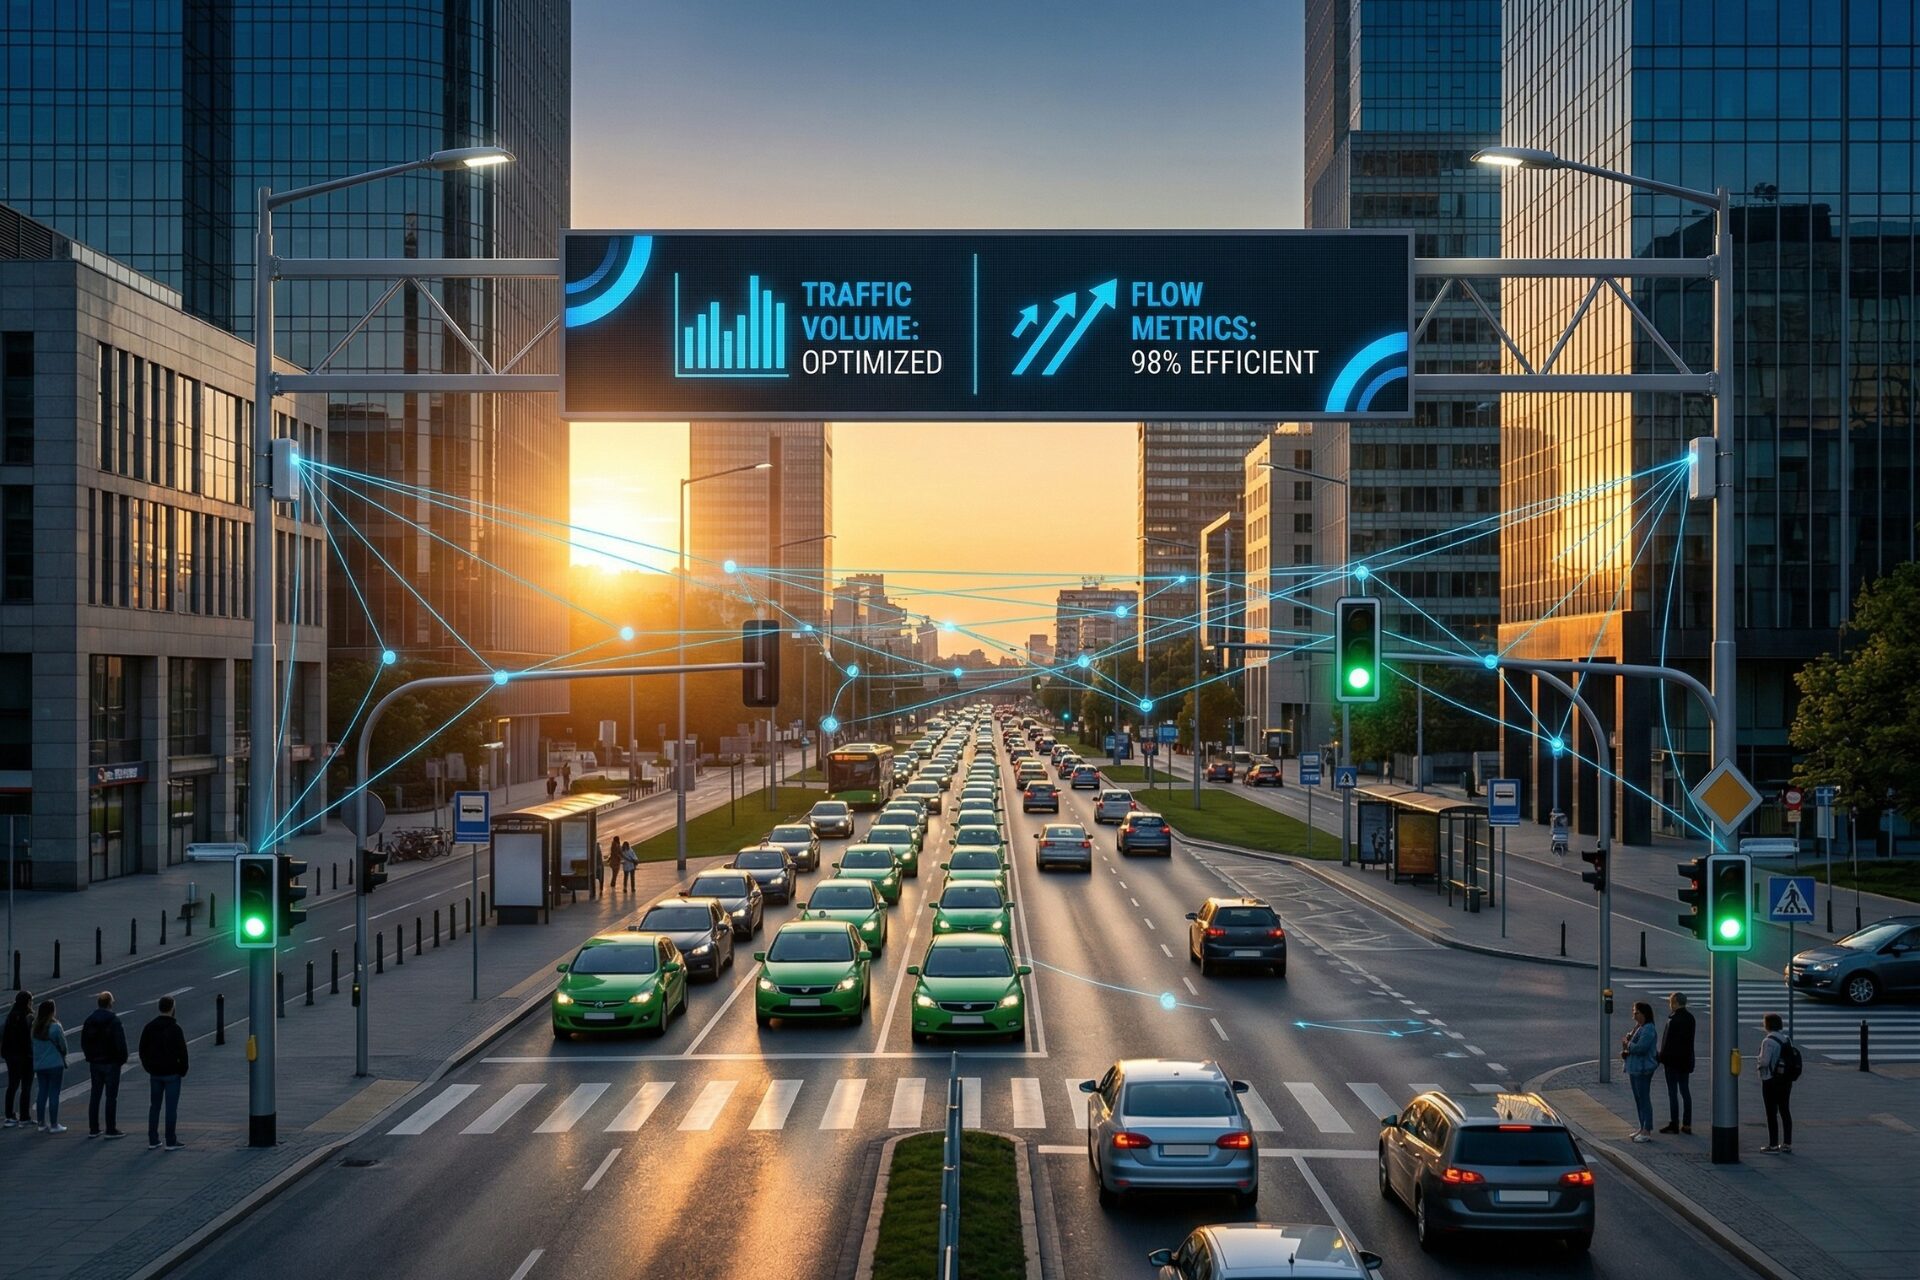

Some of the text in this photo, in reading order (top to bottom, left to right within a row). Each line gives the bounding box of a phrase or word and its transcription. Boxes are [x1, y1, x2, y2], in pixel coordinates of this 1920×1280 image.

[802, 282, 912, 306] TRAFFIC
[1132, 282, 1204, 306] FLOW
[802, 316, 919, 340] VOLUME:
[1132, 316, 1257, 340] METRICS:
[802, 350, 942, 374] OPTIMIZED
[1132, 350, 1319, 374] 98% EFFICIENT
